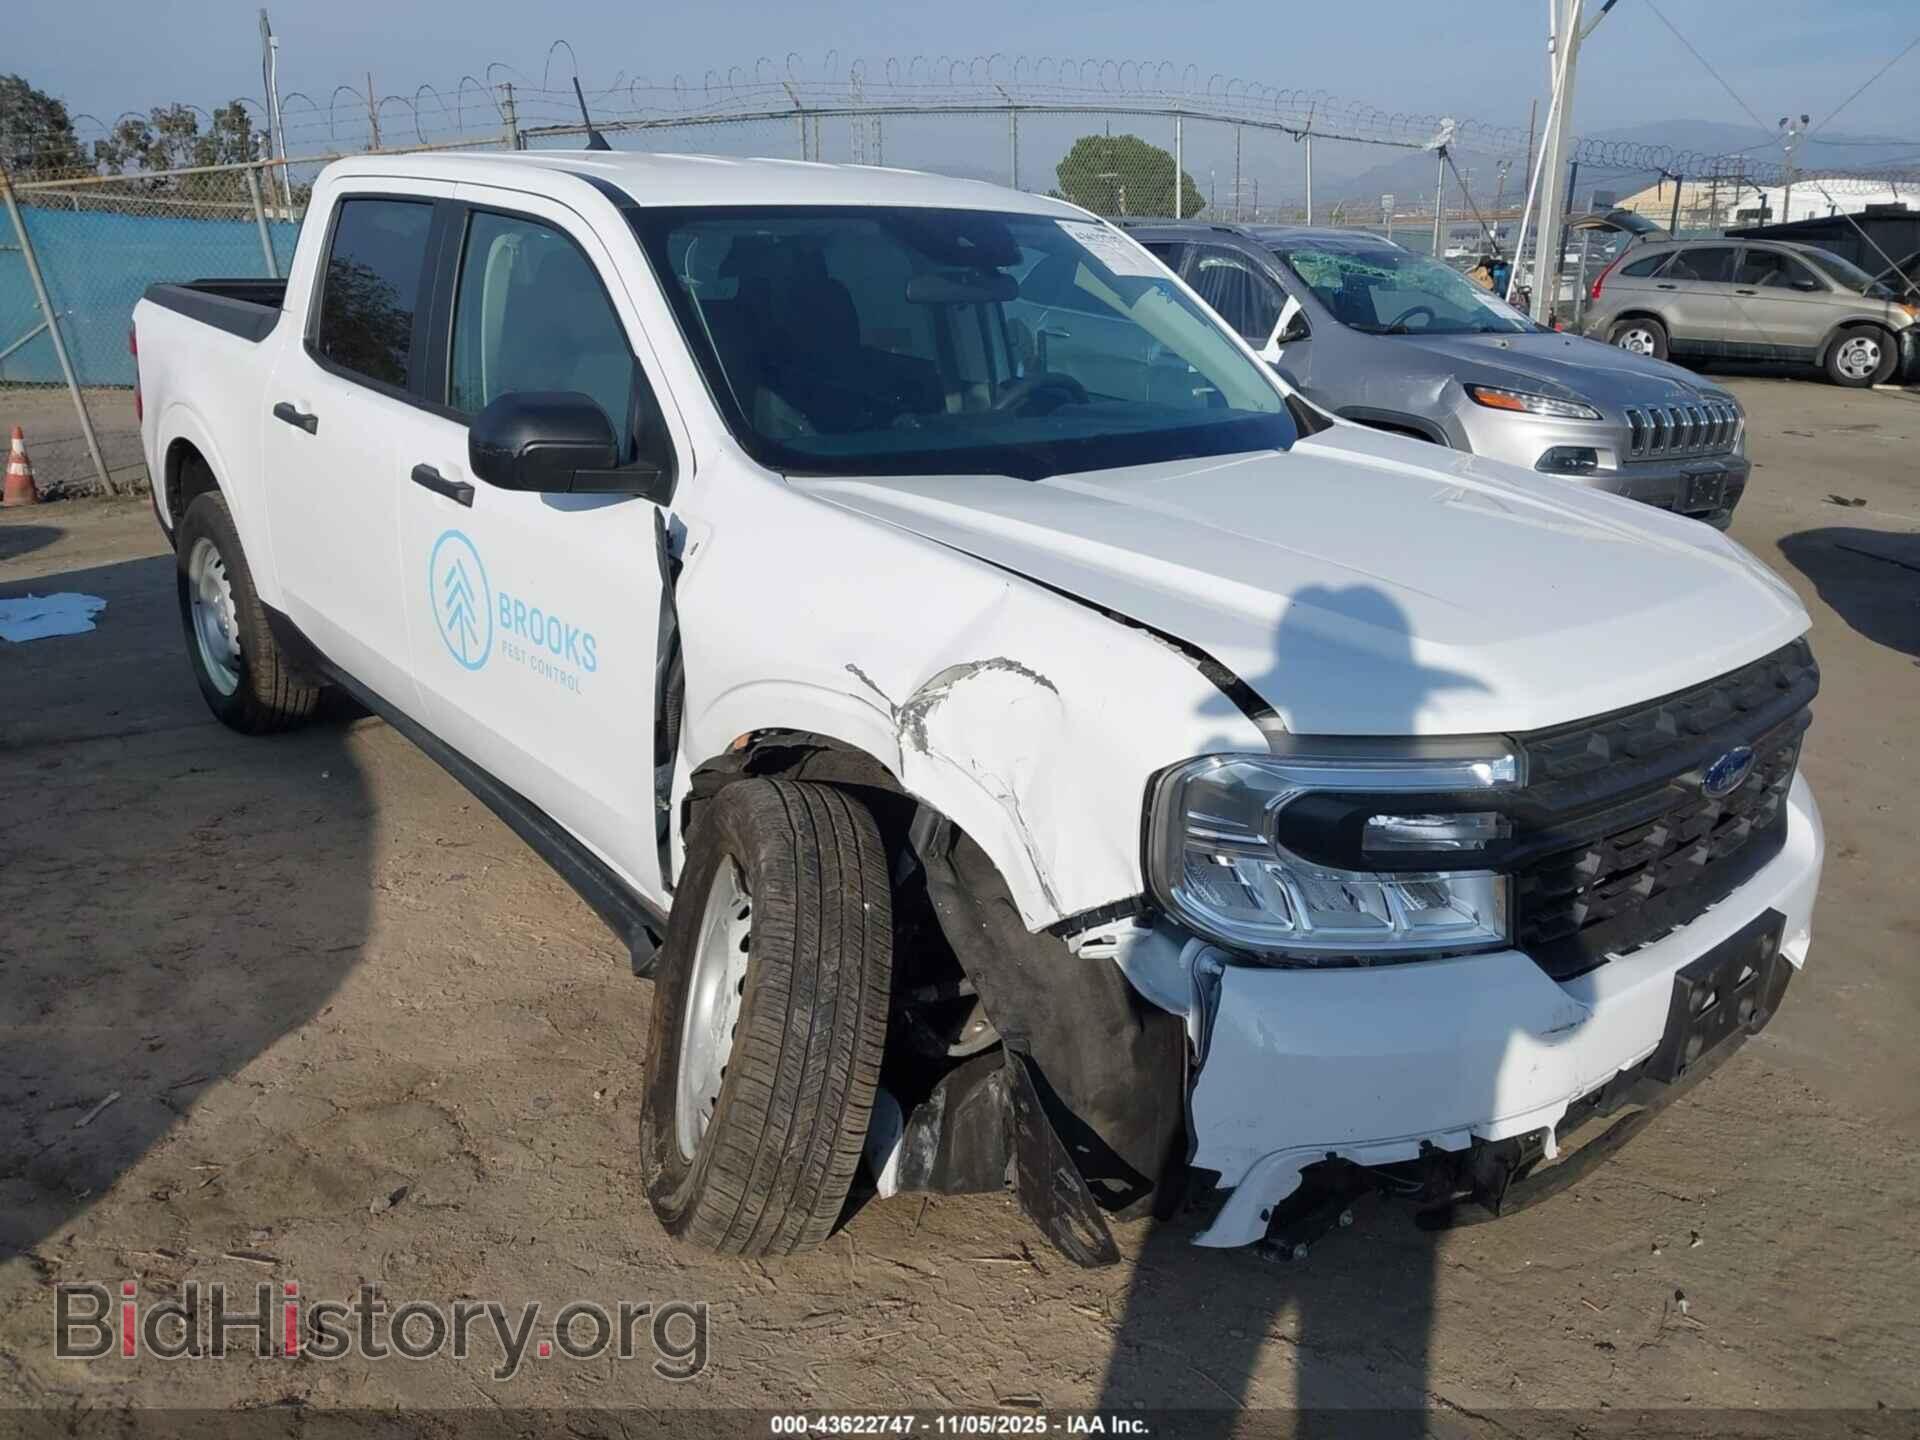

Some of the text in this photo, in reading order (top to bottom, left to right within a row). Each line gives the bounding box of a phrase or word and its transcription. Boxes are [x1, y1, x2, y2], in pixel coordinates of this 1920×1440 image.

[499, 592, 597, 672] BROOKS
[502, 640, 583, 695] PEST CONTROL
